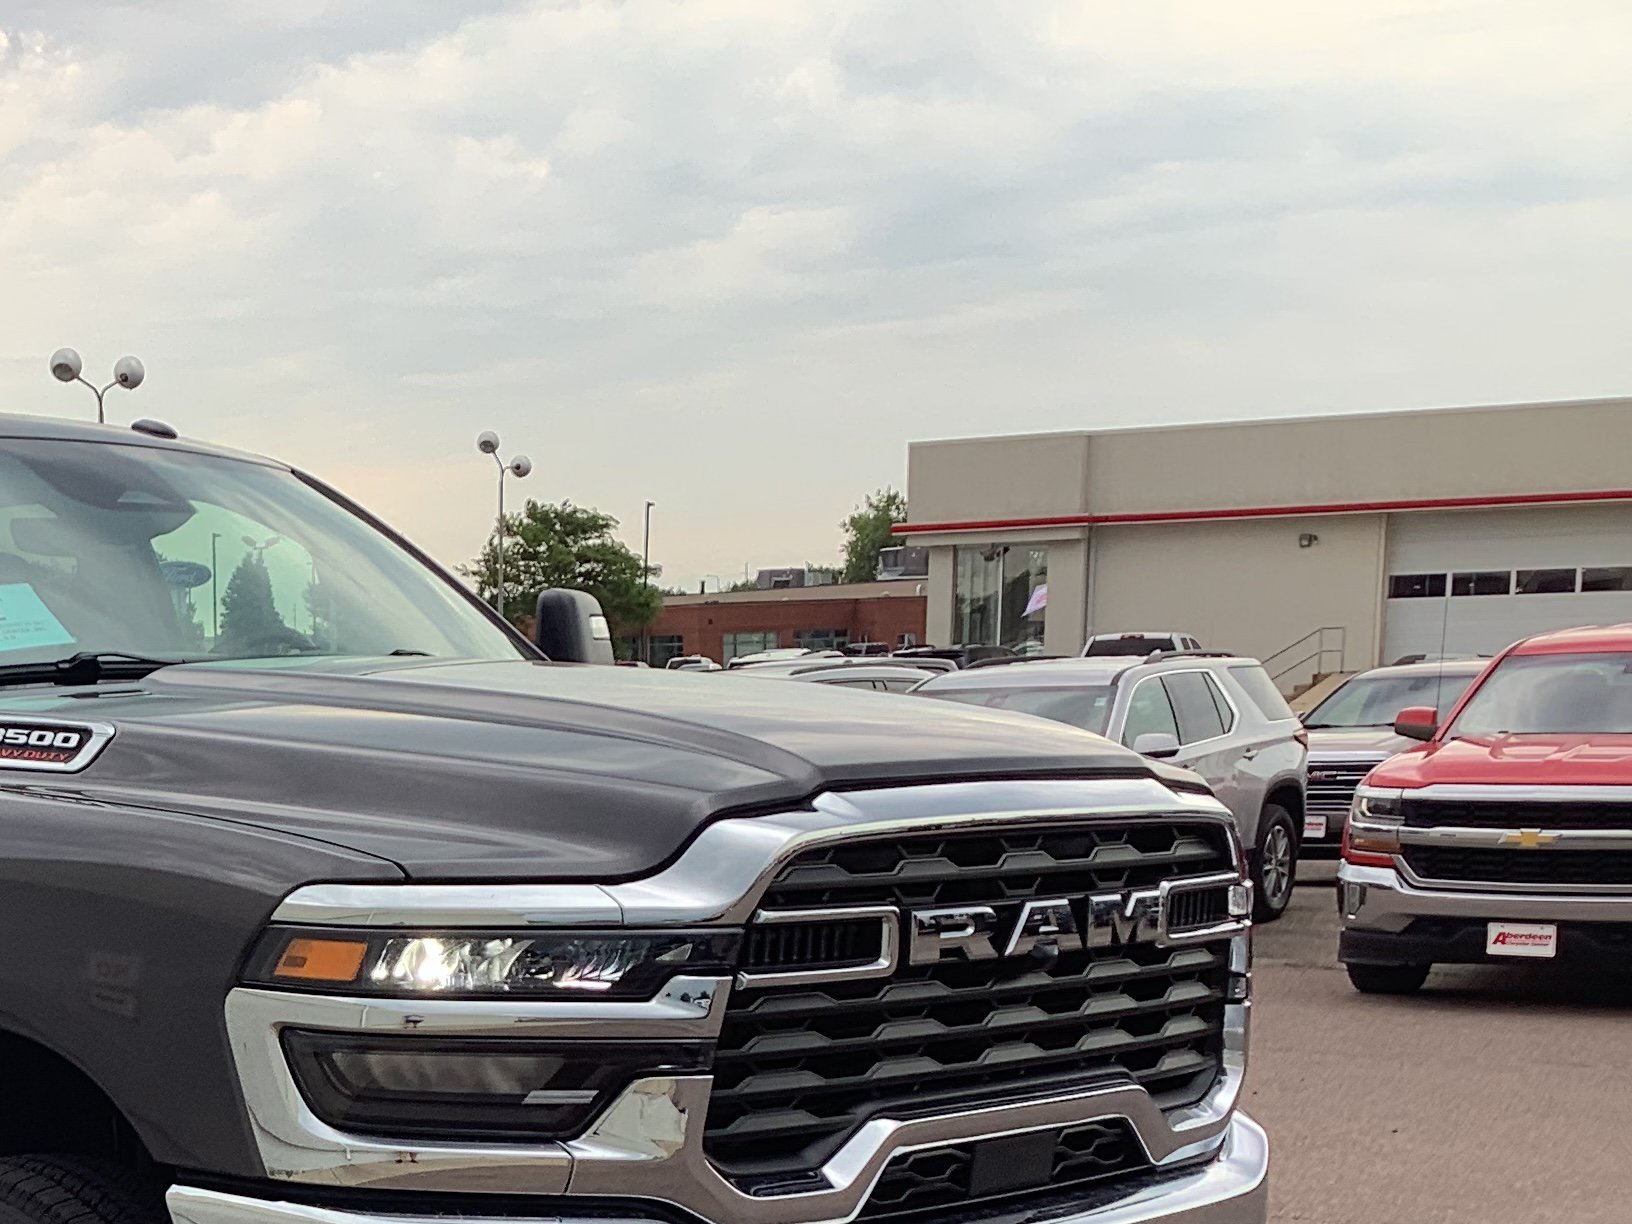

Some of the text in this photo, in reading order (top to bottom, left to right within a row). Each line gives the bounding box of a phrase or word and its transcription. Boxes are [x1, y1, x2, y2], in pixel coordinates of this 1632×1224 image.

[23, 750, 70, 760] DUTY
[909, 890, 1161, 965] RAM
[1492, 932, 1553, 945] Aberdeen
